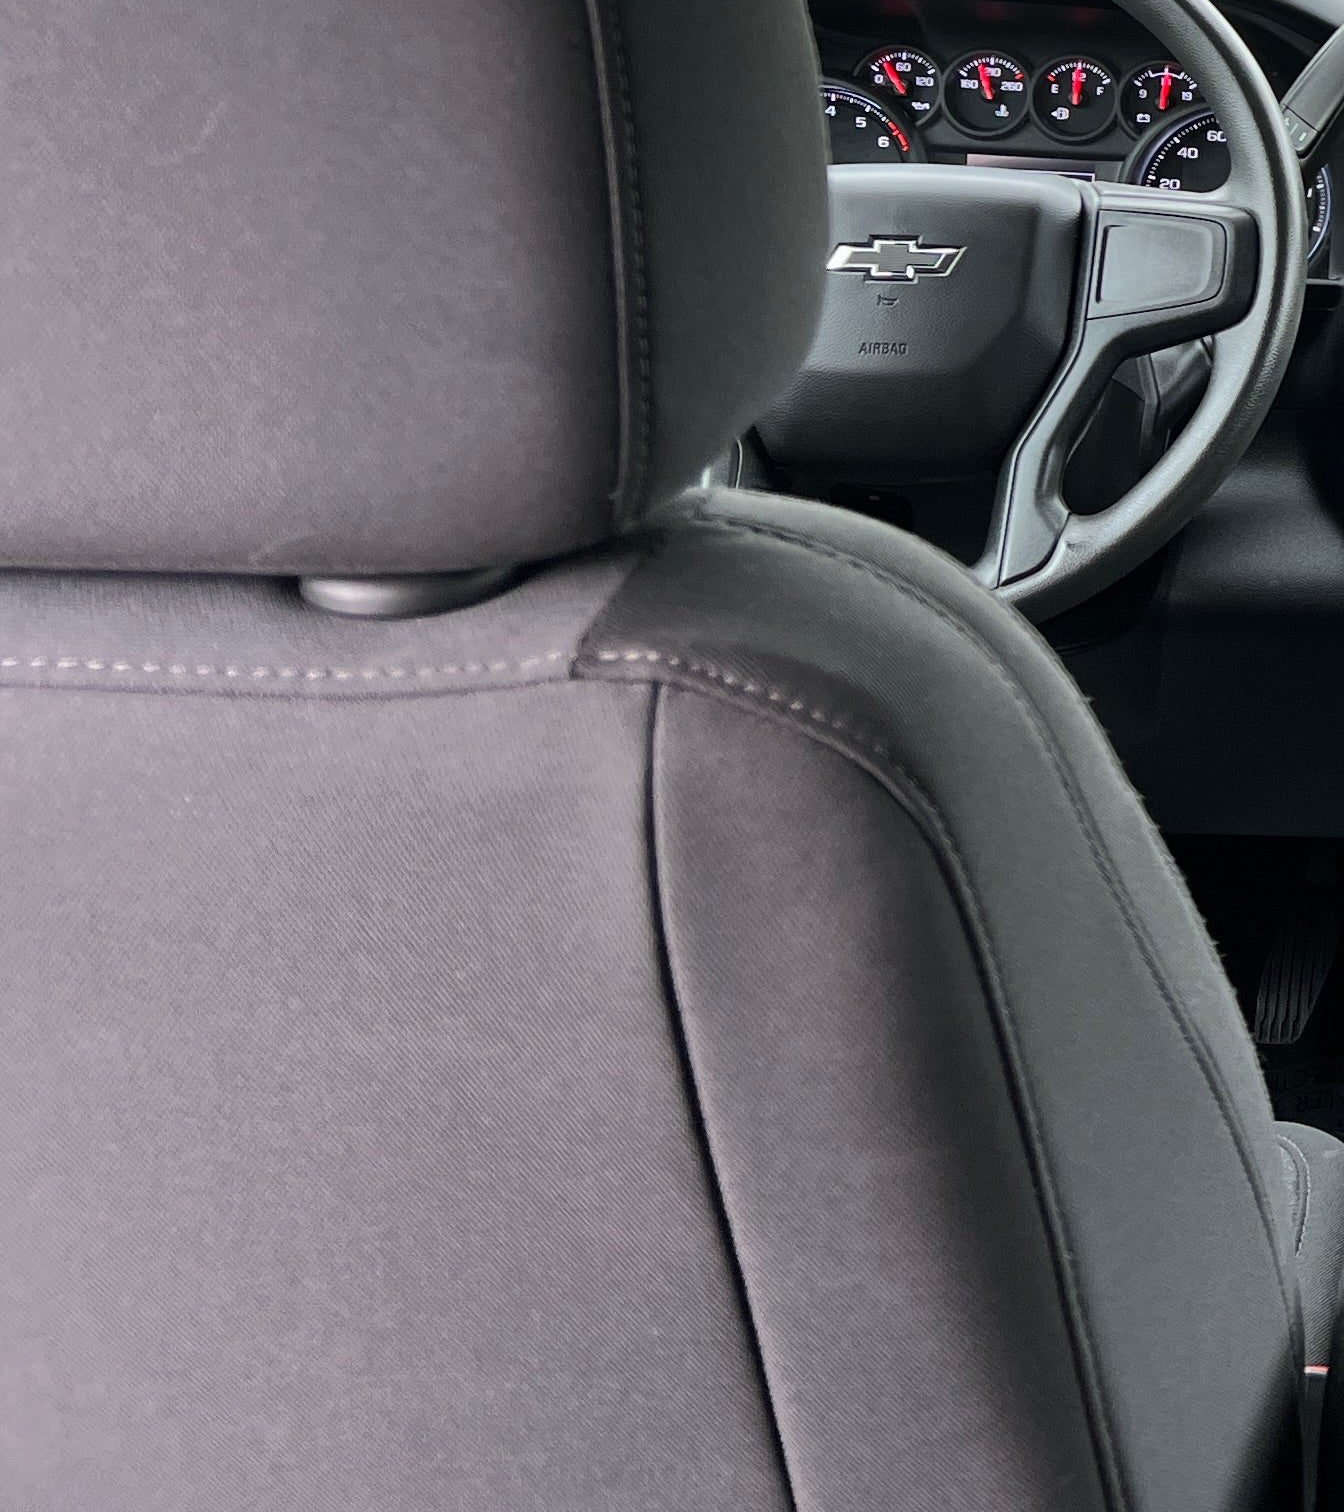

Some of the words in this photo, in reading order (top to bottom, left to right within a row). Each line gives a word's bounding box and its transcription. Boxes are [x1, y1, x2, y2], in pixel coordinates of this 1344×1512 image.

[895, 61, 912, 72] 60
[1050, 83, 1060, 94] E
[1096, 85, 1105, 96] F
[1138, 88, 1148, 99] 9
[824, 105, 837, 117] 4
[855, 116, 867, 128] 5
[877, 135, 890, 148] 6
[1176, 146, 1199, 159] 40
[1159, 178, 1181, 190] 20
[858, 341, 908, 356] AIRBAG
